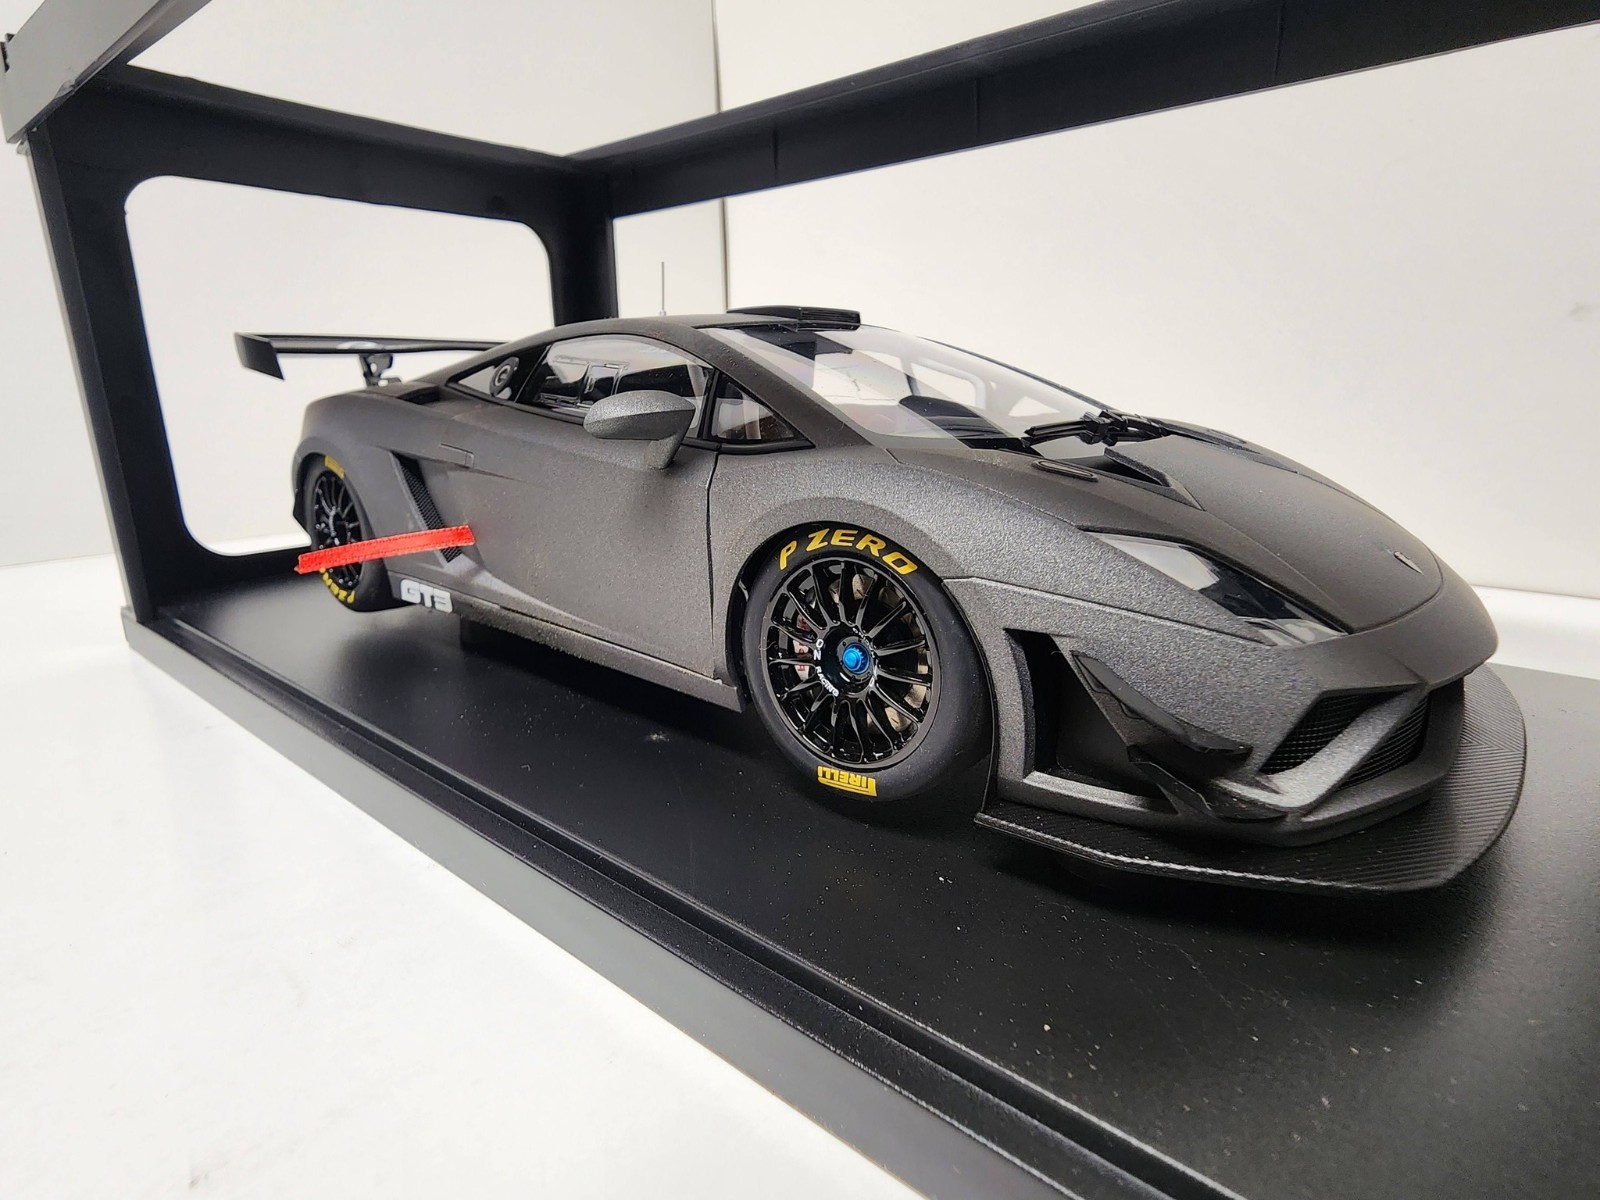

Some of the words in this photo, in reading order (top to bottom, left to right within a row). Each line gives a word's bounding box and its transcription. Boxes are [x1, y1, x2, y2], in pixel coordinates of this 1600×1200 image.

[779, 540, 798, 571] P
[805, 528, 919, 576] ZERO
[400, 578, 453, 613] GT3
[815, 665, 840, 698] RACING
[817, 765, 878, 797] PIRELLI
